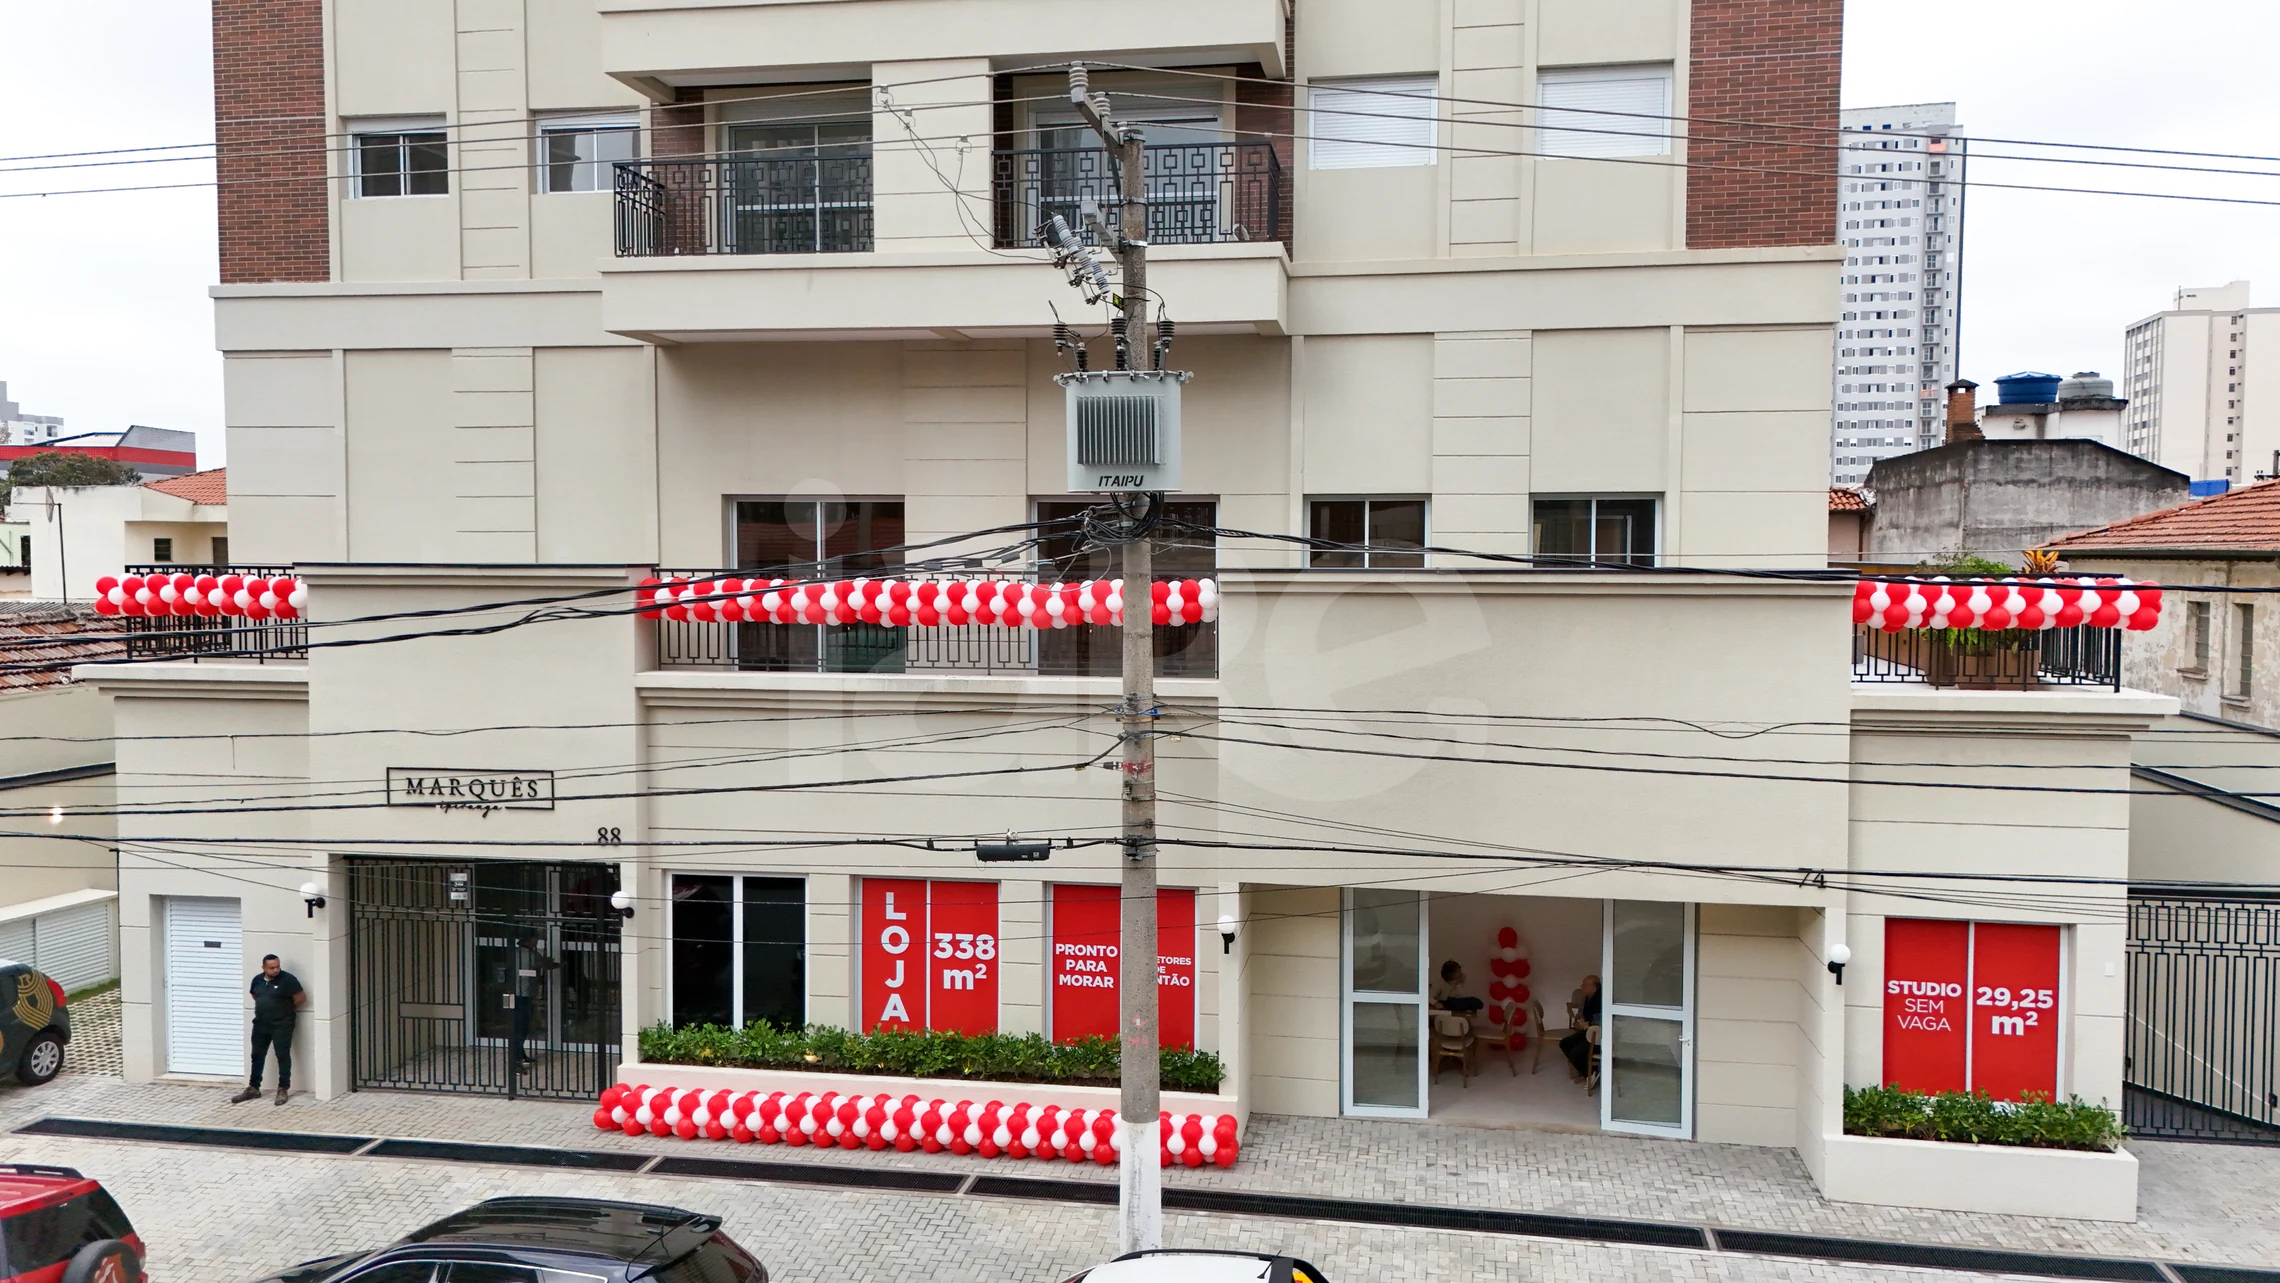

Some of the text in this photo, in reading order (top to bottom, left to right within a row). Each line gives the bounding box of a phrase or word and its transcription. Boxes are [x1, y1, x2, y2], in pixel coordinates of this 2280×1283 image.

[1098, 475, 1144, 487] ITAIPU
[405, 776, 539, 801] MARQUÊS
[597, 827, 621, 846] 88
[1798, 867, 1827, 888] 74
[933, 932, 996, 960] 338
[1055, 943, 1119, 957] PRONTO
[881, 891, 910, 1023] LOJA
[1065, 958, 1107, 972] PARA
[1157, 956, 1192, 966] ETORES
[1059, 974, 1114, 988] MORAR
[1157, 973, 1191, 987] NTÃO
[1887, 980, 1962, 997] STUDIO
[1904, 998, 1944, 1013] SEM
[1975, 986, 2054, 1011] 29,25
[1897, 1015, 1952, 1031] VAGA
